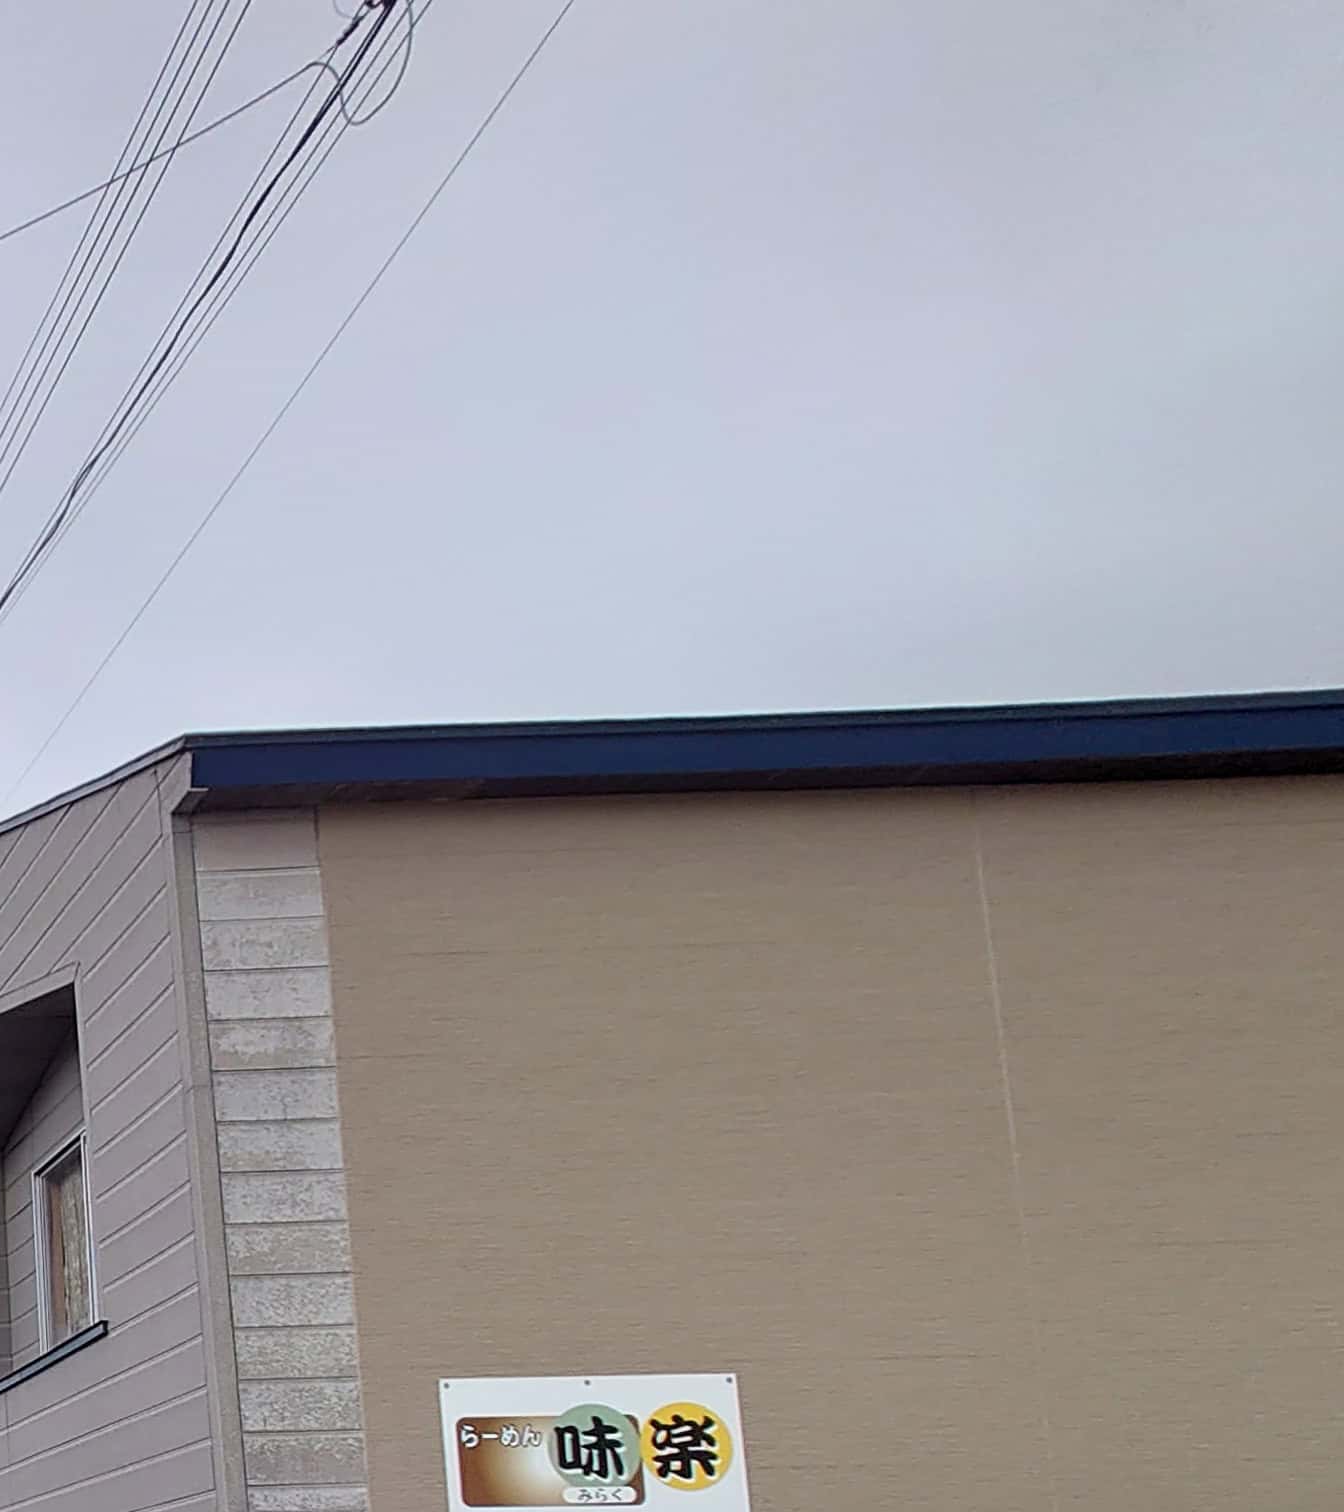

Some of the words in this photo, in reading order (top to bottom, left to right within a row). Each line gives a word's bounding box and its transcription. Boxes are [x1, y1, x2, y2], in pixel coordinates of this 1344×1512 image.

[461, 1423, 542, 1448] らーめん
[554, 1415, 718, 1480] 味楽
[577, 1488, 624, 1502] みらく
